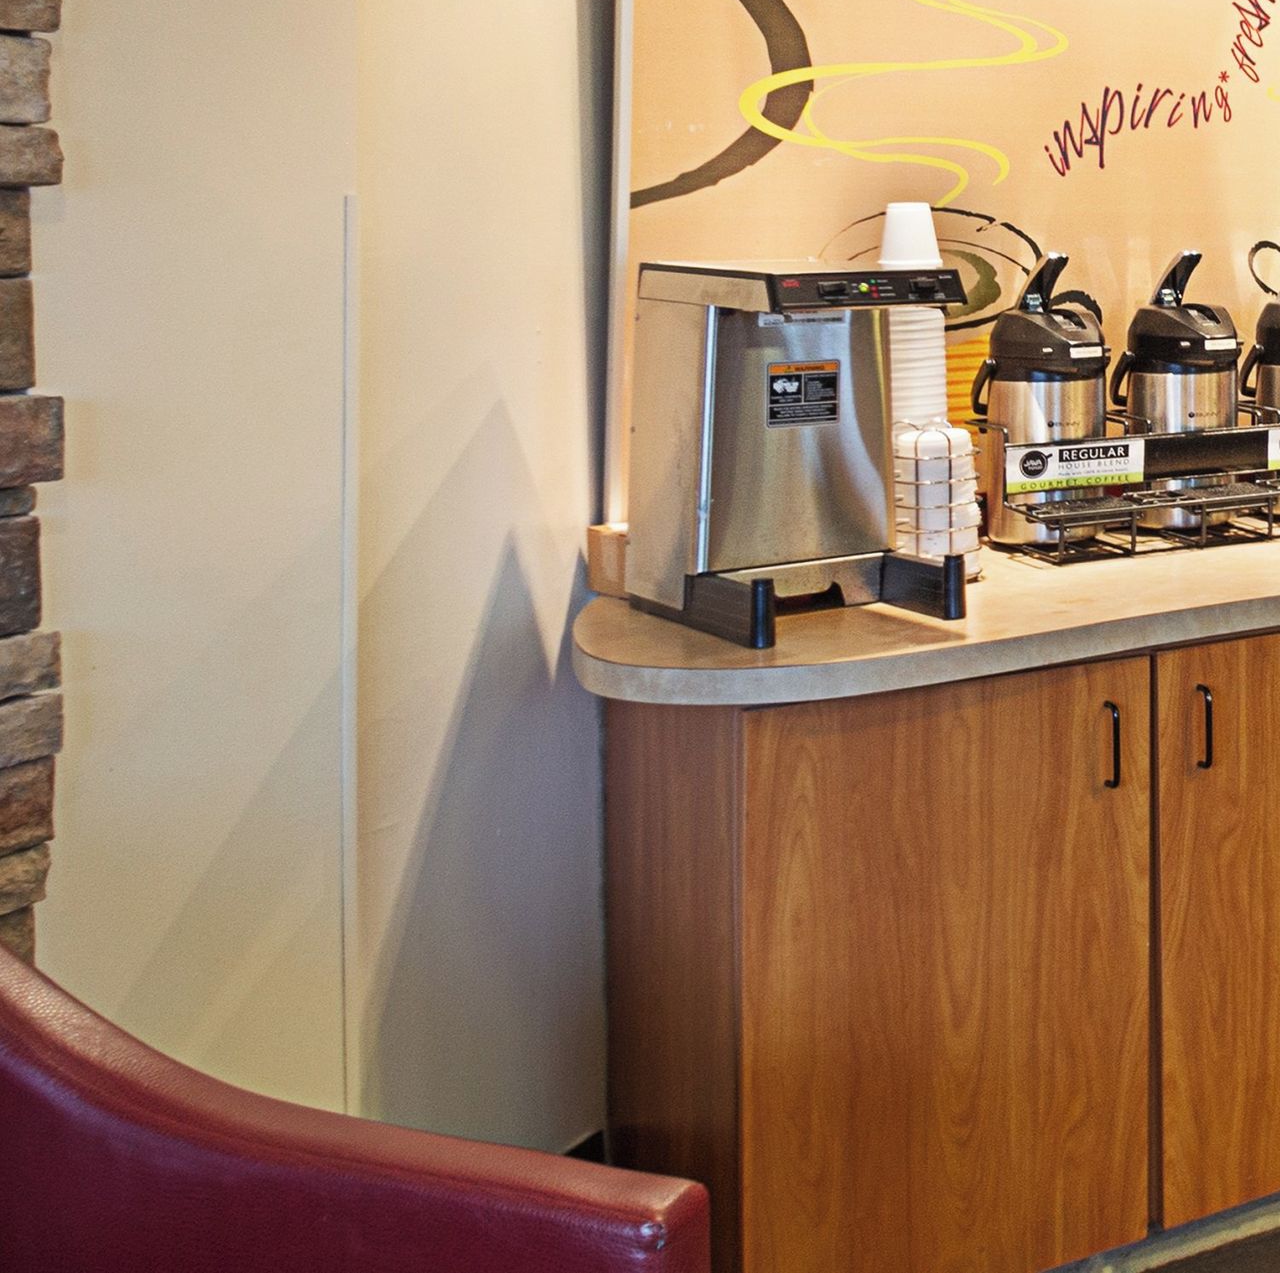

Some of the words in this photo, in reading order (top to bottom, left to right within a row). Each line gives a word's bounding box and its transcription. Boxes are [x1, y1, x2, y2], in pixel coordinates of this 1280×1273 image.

[1062, 446, 1126, 461] REGULAR
[1058, 461, 1092, 471] HOUSE
[1097, 458, 1130, 468] BLEND
[1020, 478, 1078, 490] GOURMET
[1086, 474, 1130, 486] COFFEE
